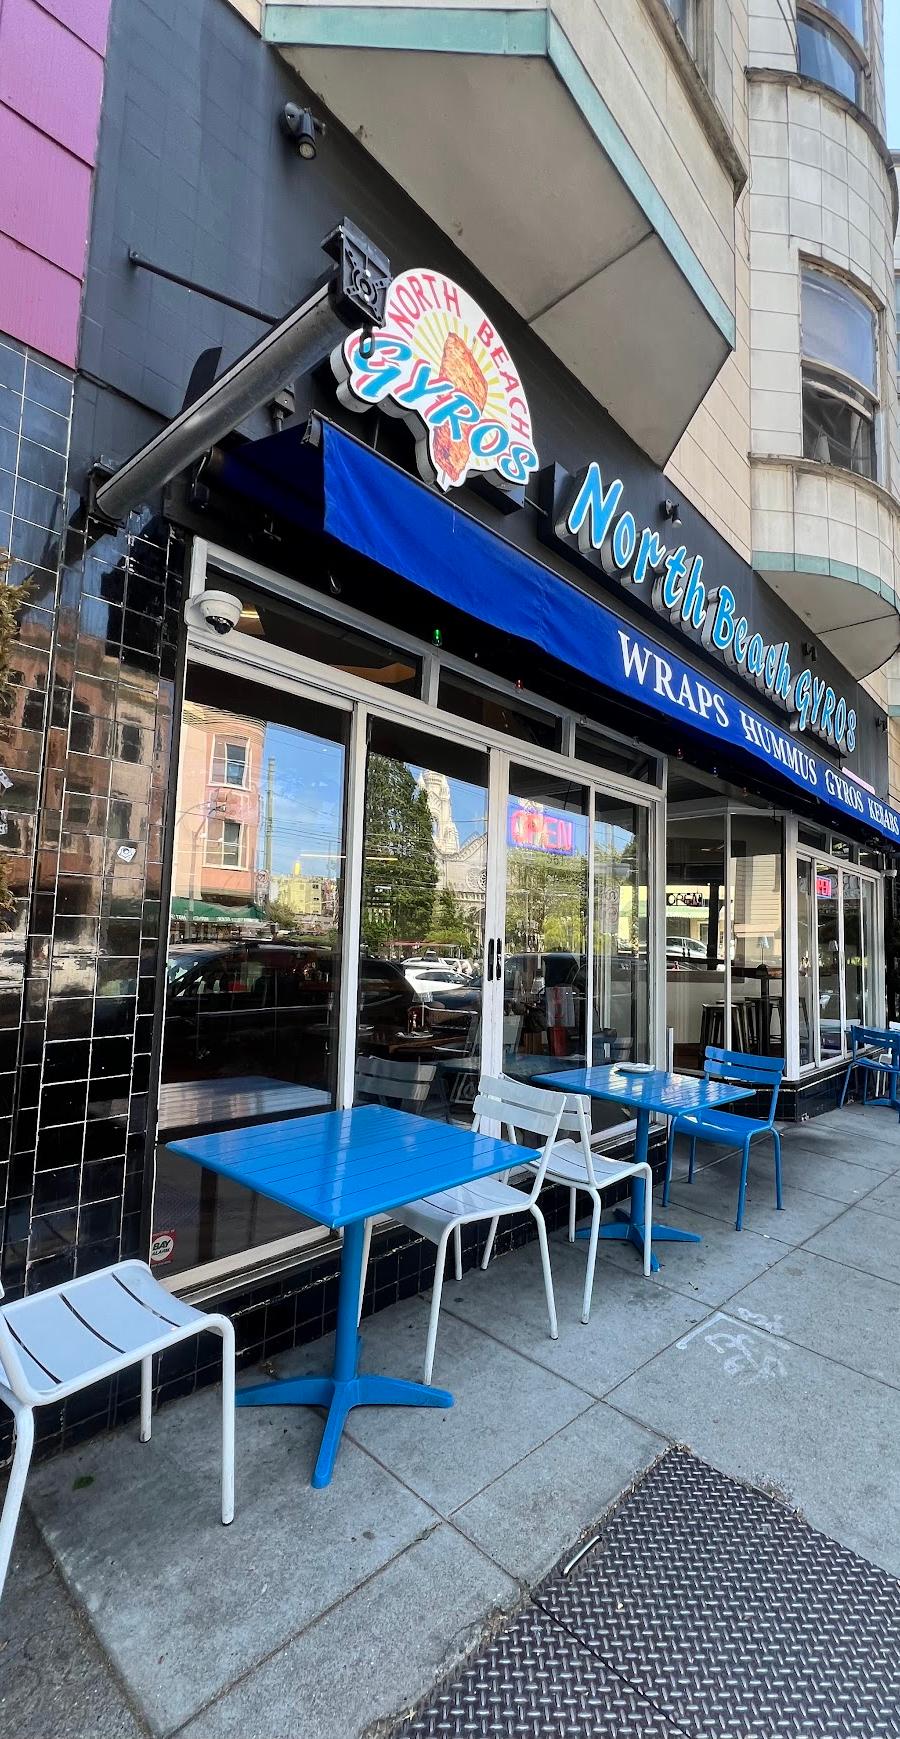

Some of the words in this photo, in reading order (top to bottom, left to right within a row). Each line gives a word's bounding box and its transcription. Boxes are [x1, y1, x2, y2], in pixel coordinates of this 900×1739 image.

[350, 335, 537, 480] GYROS
[388, 273, 461, 339] NORTH
[477, 319, 530, 439] BEACH
[567, 461, 706, 629] North
[712, 585, 791, 700] Beach
[617, 629, 730, 728] WRAPS
[738, 709, 818, 786] HUMMUS
[825, 769, 864, 813] GYROS
[867, 796, 900, 836] KEBABS
[511, 809, 572, 851] OPEN
[153, 1239, 171, 1250] BAY
